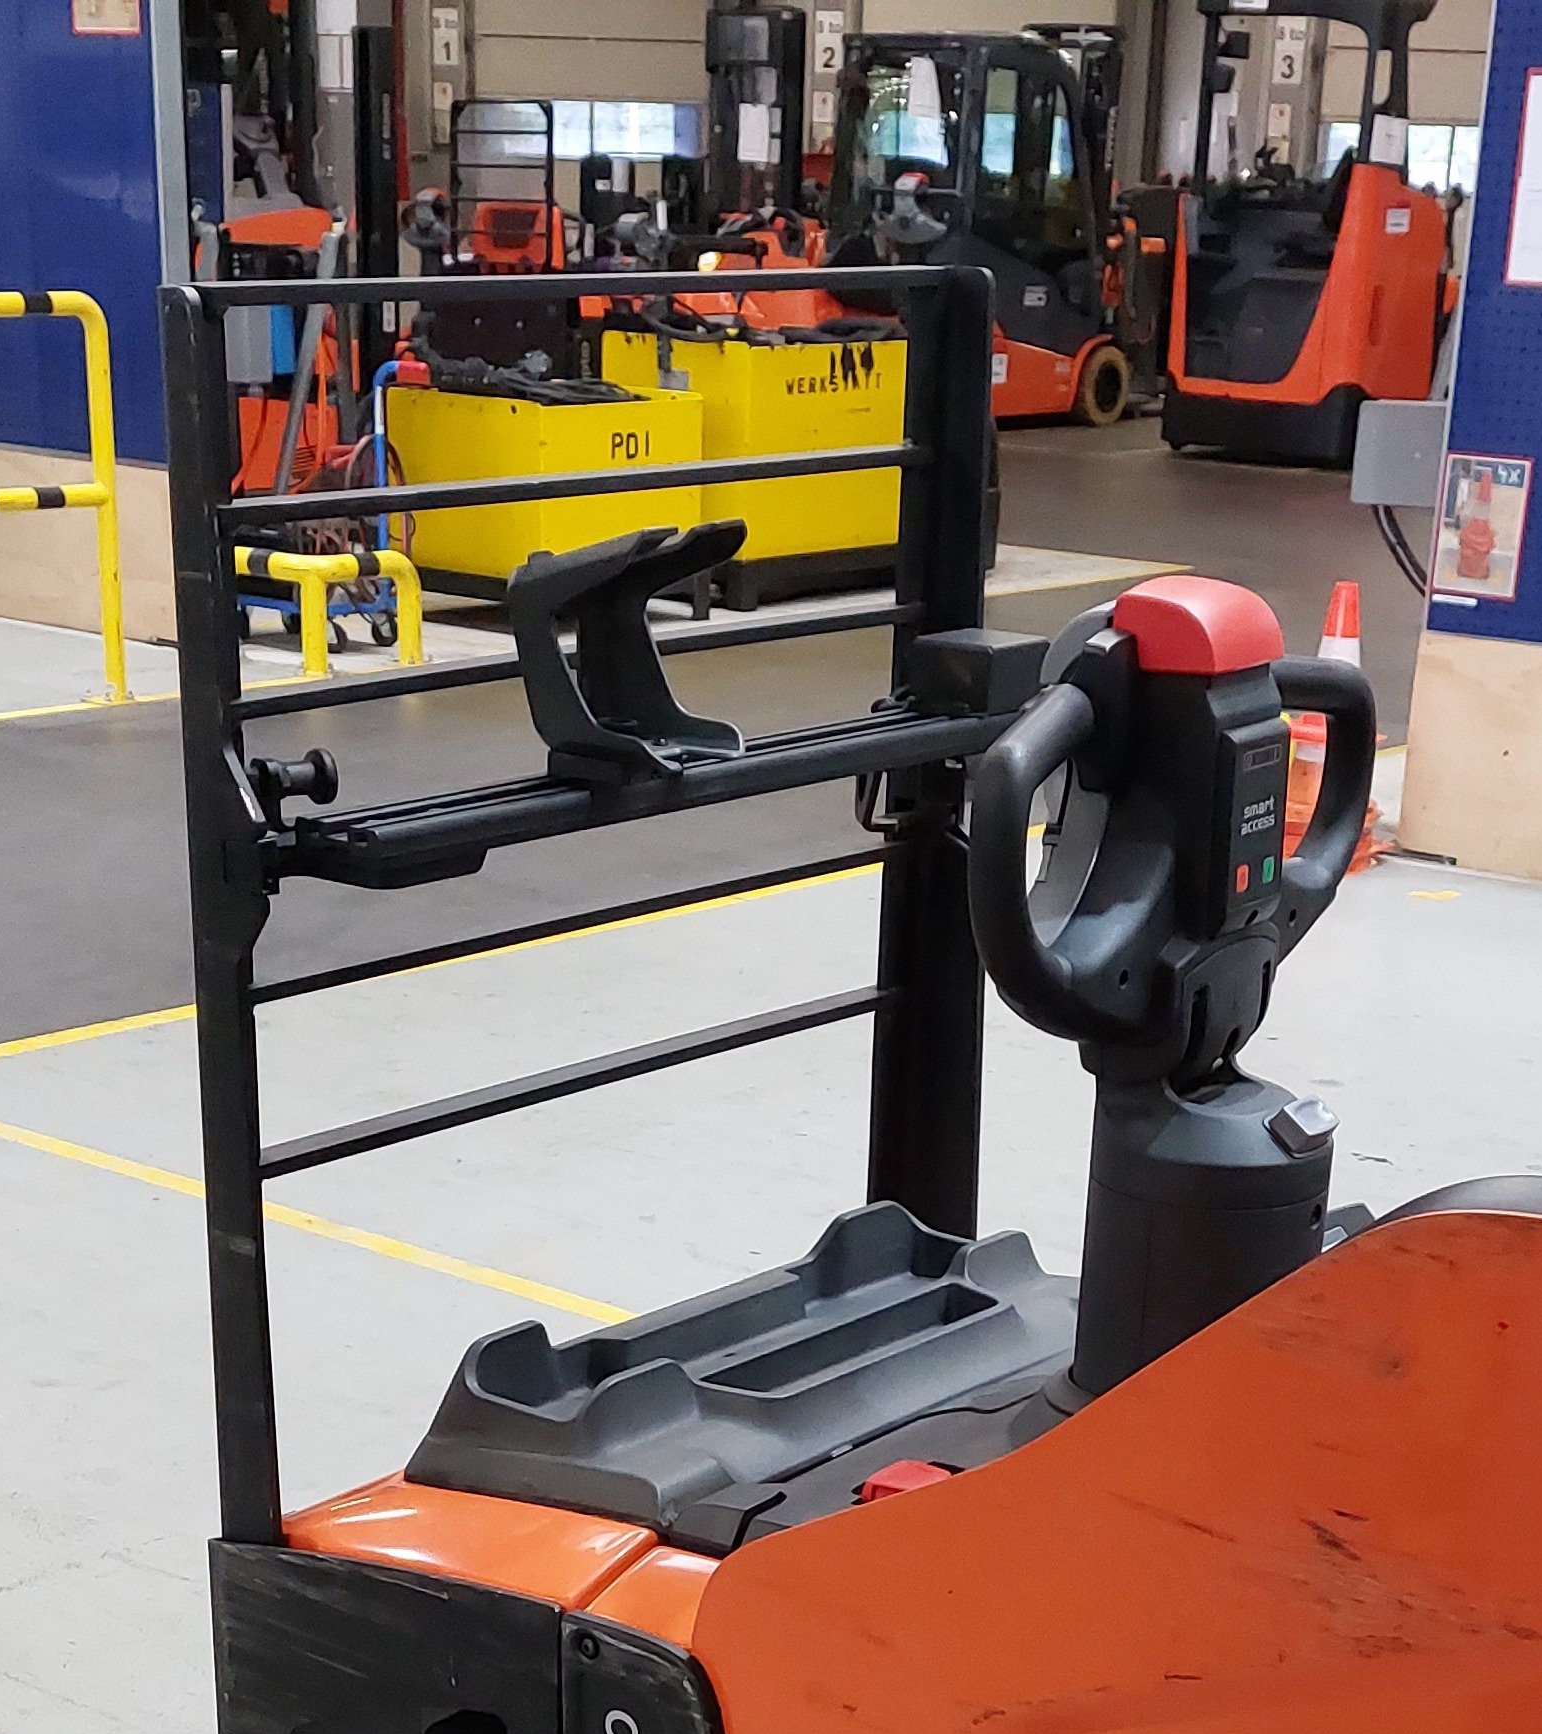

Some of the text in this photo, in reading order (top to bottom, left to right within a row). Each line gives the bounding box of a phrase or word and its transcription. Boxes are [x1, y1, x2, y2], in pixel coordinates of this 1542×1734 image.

[443, 41, 451, 61] 1
[822, 46, 836, 69] 2
[1280, 54, 1295, 80] 3
[1243, 796, 1275, 819] smart
[1240, 814, 1275, 836] access
